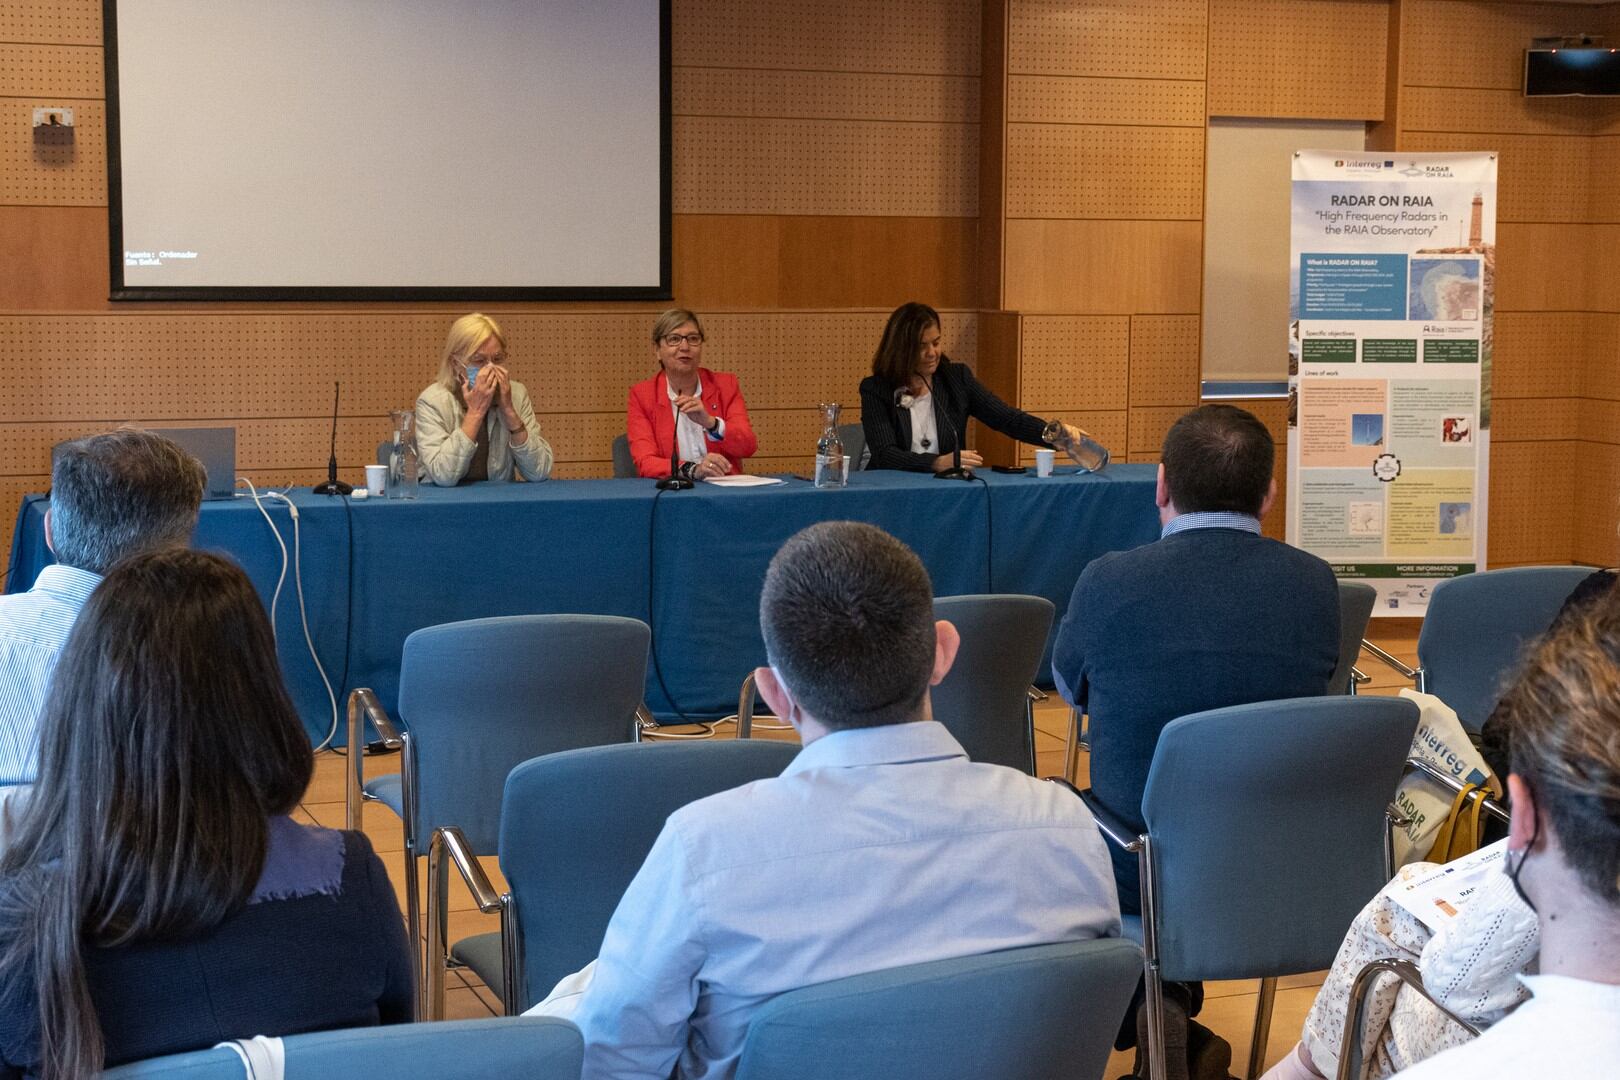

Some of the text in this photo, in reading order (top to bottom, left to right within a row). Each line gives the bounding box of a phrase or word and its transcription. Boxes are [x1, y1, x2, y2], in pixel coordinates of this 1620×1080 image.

[1331, 195, 1433, 207] RADAR ON RAIA
[1346, 211, 1397, 223] Frequency
[1401, 211, 1437, 221] Radars
[1439, 211, 1448, 221] in
[1325, 225, 1341, 235] the
[1344, 225, 1368, 235] RAIA
[1418, 725, 1467, 775] nterreg
[1397, 791, 1426, 828] RADAR
